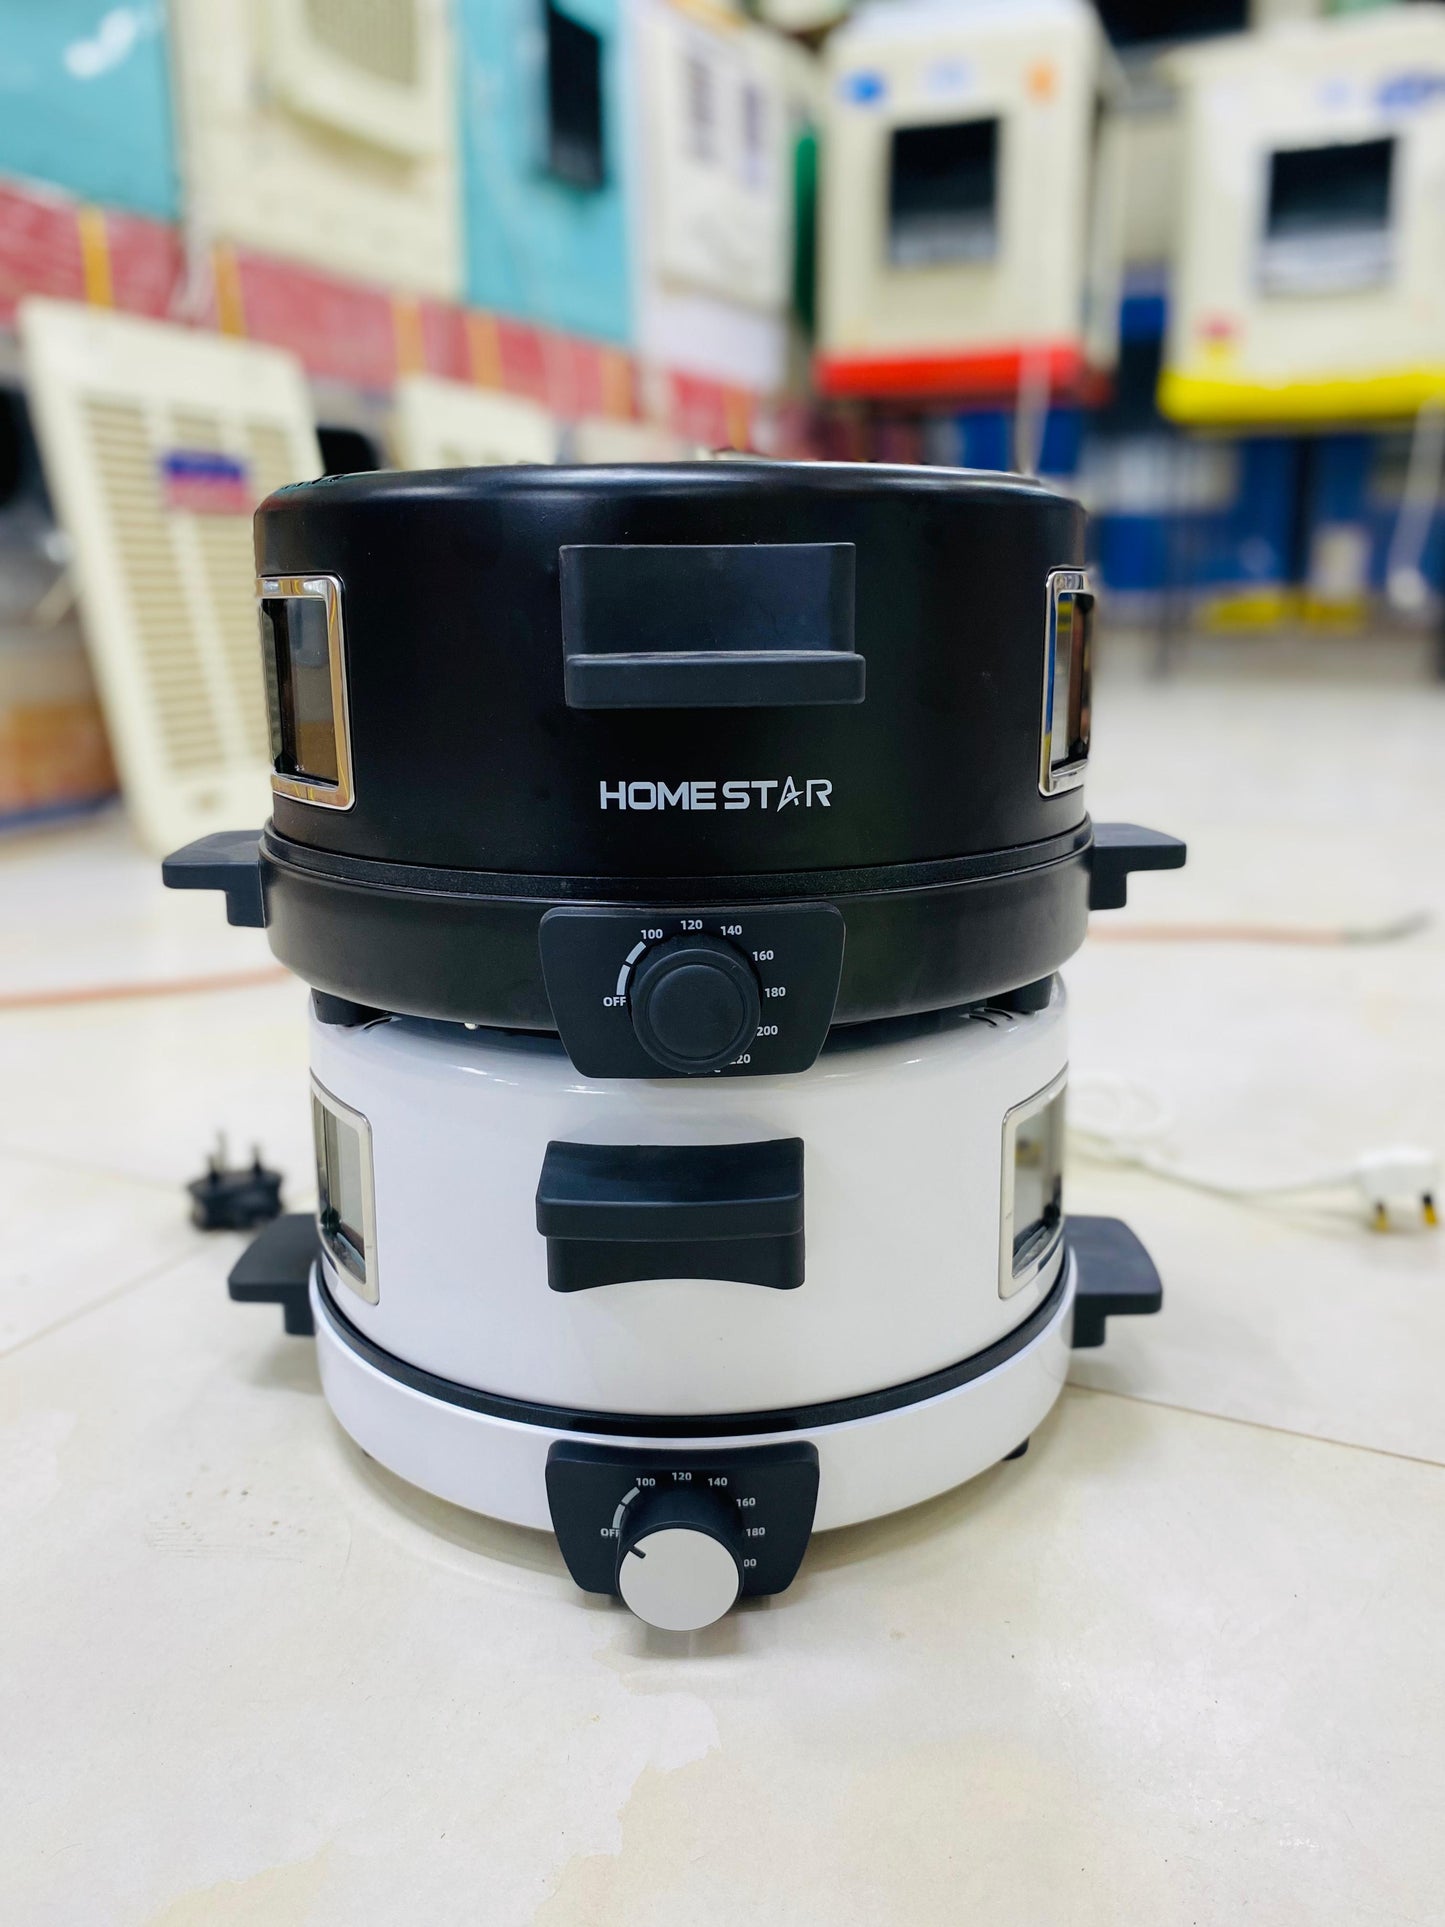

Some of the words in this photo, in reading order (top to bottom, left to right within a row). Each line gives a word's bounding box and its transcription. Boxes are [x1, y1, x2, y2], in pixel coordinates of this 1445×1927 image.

[600, 780, 717, 811] HOME
[722, 775, 833, 812] STAR
[680, 919, 703, 931] 120
[720, 924, 743, 936] 140
[640, 928, 664, 940] 100
[752, 949, 774, 962] 160
[764, 986, 786, 998] 180
[602, 996, 627, 1007] OFF
[756, 1025, 779, 1037] 200
[729, 1053, 751, 1065] 20
[635, 1477, 656, 1487] 100
[671, 1472, 692, 1482] 120
[707, 1477, 728, 1487] 140
[736, 1497, 756, 1508] 160
[746, 1526, 766, 1537] 180
